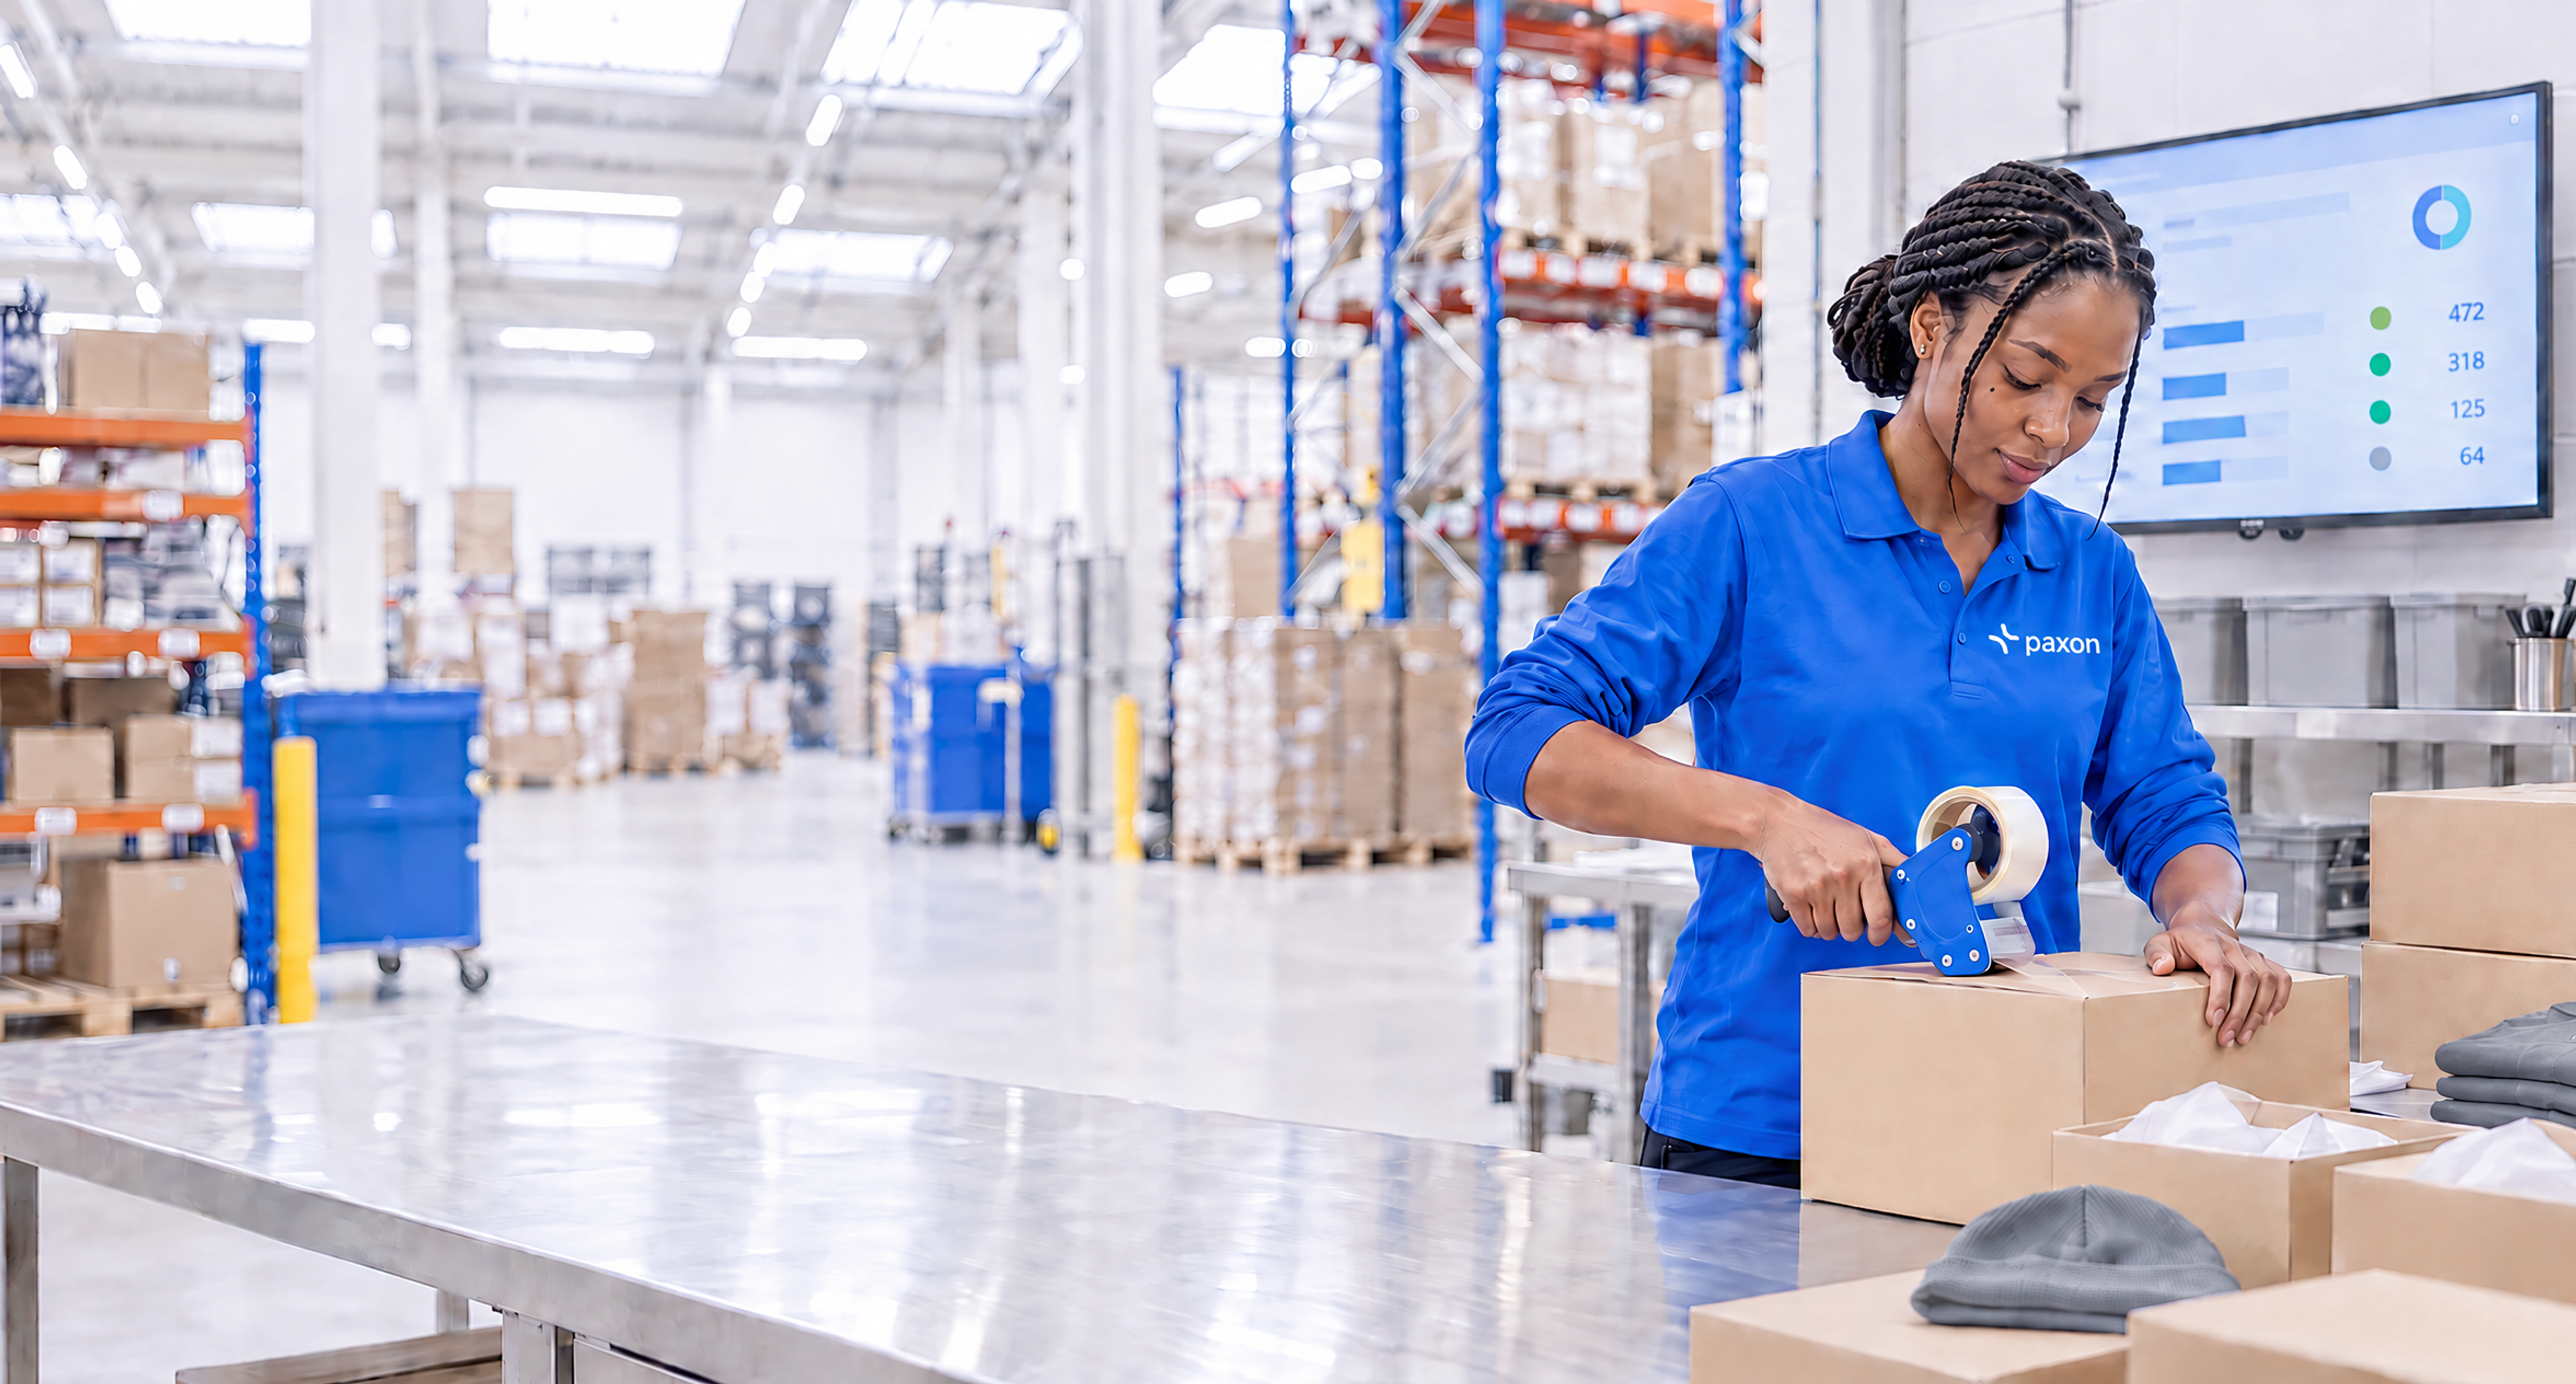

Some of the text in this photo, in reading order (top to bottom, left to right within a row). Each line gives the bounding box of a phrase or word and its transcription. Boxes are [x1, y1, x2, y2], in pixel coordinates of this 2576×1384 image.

[2449, 302, 2485, 322] 472
[2448, 351, 2485, 372] 318
[2451, 398, 2485, 419] 125
[2460, 446, 2485, 466] 64
[2025, 635, 2100, 657] paxon
